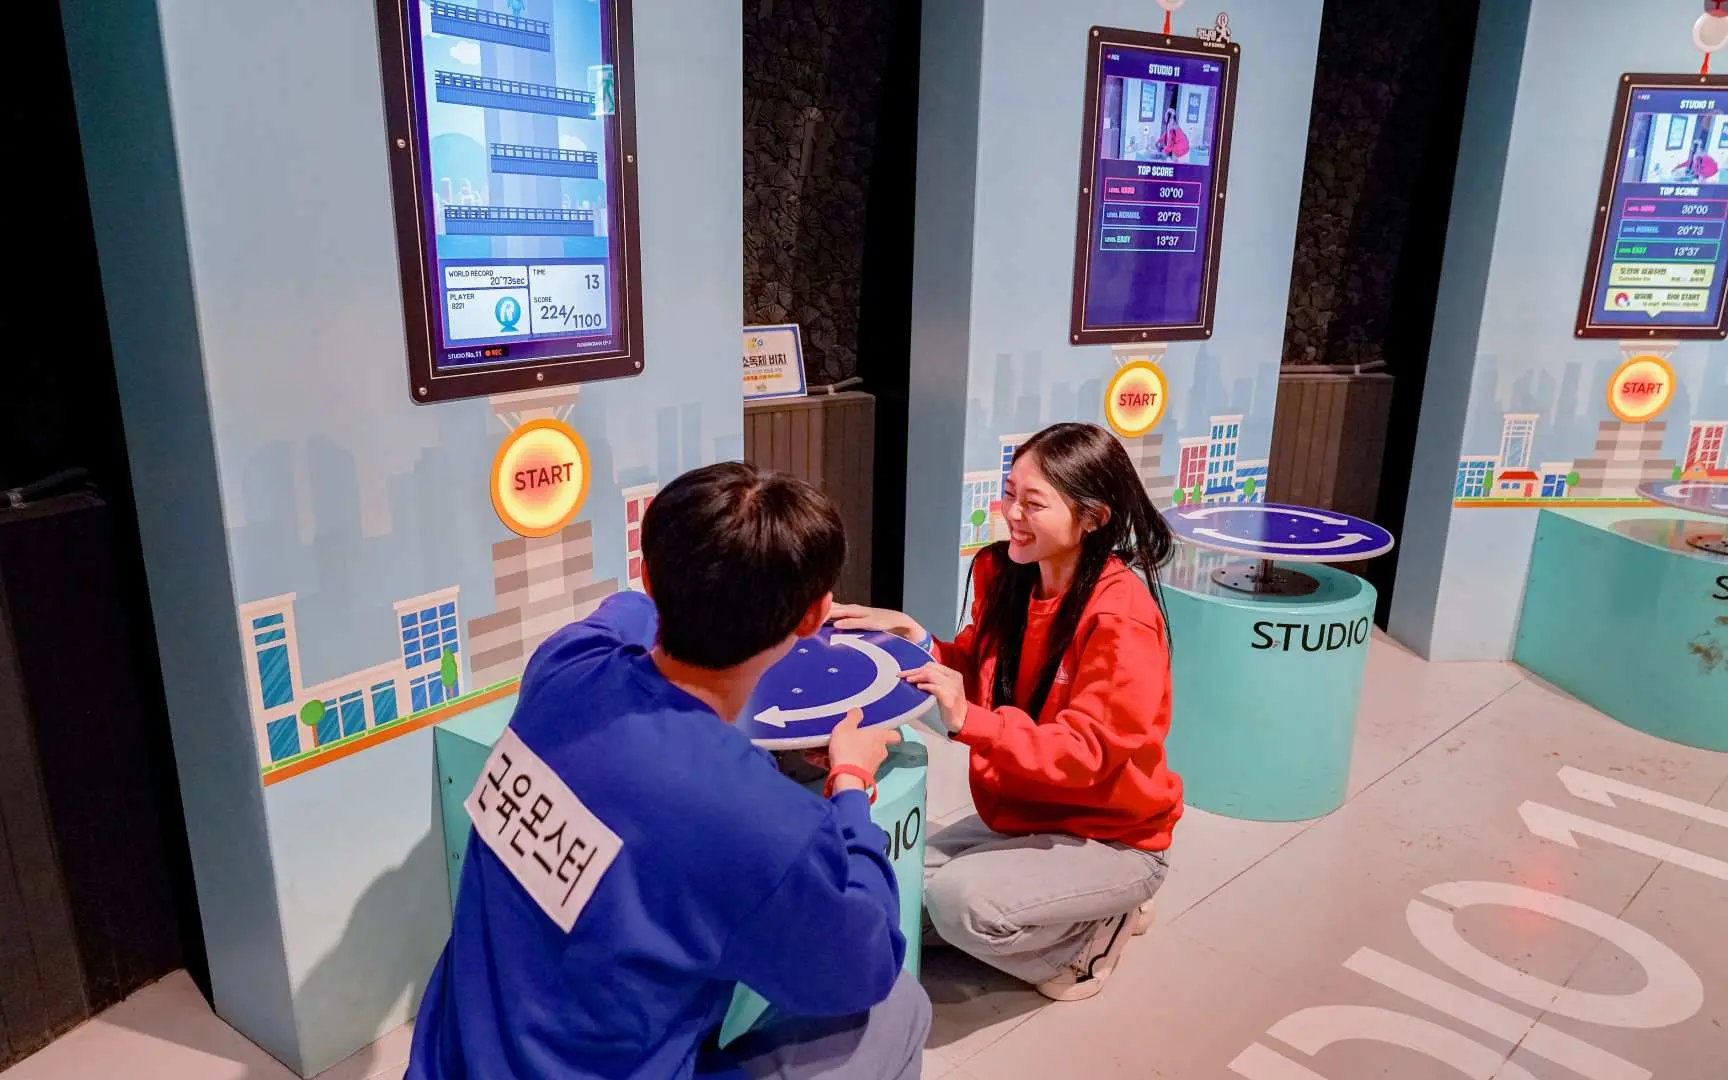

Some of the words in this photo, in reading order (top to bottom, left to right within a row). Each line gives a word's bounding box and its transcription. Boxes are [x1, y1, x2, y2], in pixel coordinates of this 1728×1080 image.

[1148, 63, 1173, 76] STUDIO
[1174, 65, 1180, 77] 11
[1680, 99, 1707, 110] STUDIO
[1707, 99, 1715, 109] 11
[1137, 165, 1151, 176] TOP
[1151, 166, 1174, 177] SCORE
[1659, 186, 1674, 196] TOP
[1674, 186, 1700, 196] SCORE
[470, 269, 494, 277] RECORD
[584, 274, 600, 290] 13
[450, 293, 475, 301] PLAYER
[451, 302, 465, 310] 8221
[768, 352, 788, 366] 비치
[1620, 382, 1665, 395] START
[1119, 393, 1158, 407] START
[514, 462, 574, 492] START
[1251, 616, 1369, 652] STUDIO
[478, 752, 599, 908] 근육몬스터
[1517, 765, 1728, 881] 11
